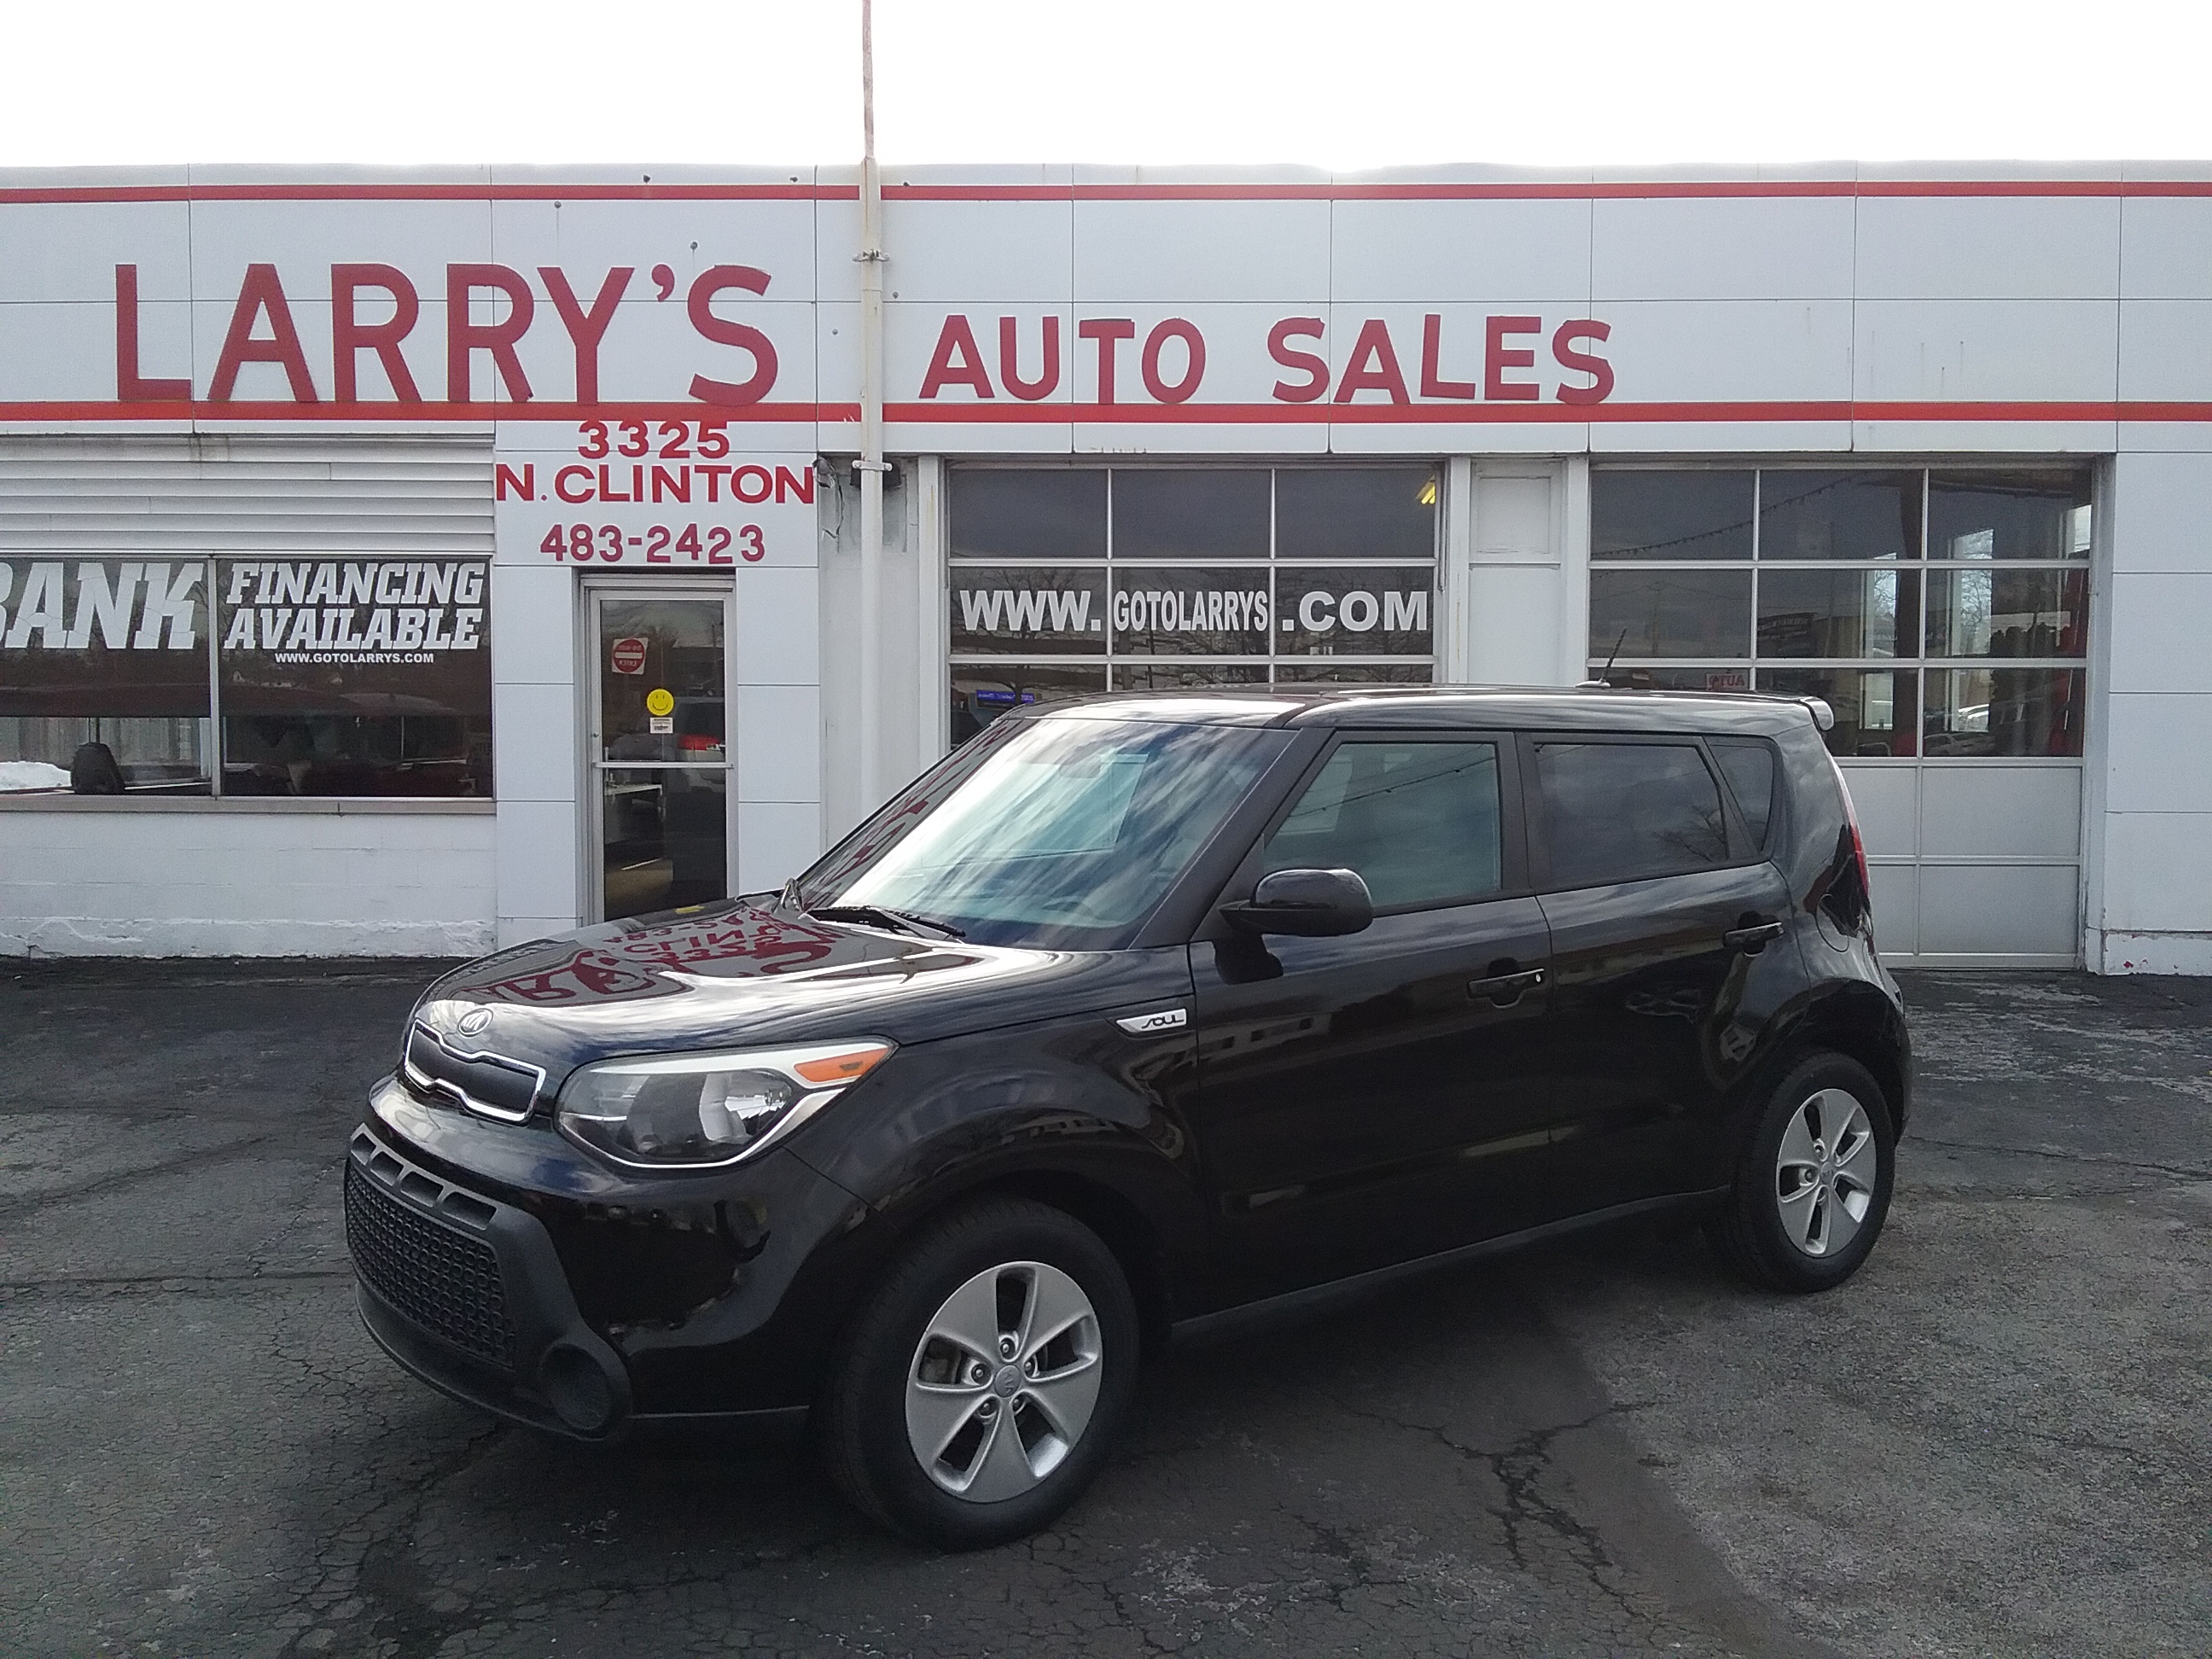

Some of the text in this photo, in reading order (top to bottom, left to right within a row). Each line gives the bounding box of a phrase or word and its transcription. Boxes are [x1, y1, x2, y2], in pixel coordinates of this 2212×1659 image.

[116, 264, 778, 406] LARRY'S
[919, 314, 1615, 405] AUTO SALES
[578, 419, 730, 459] 3325
[540, 523, 765, 564] 483-2423
[225, 562, 486, 604] FINANCING
[0, 562, 204, 649] ANK
[224, 608, 483, 649] AVAILABLE
[274, 653, 434, 663] WWW.GOTOLARRYS.COM
[1141, 1015, 1185, 1029] SOUL
